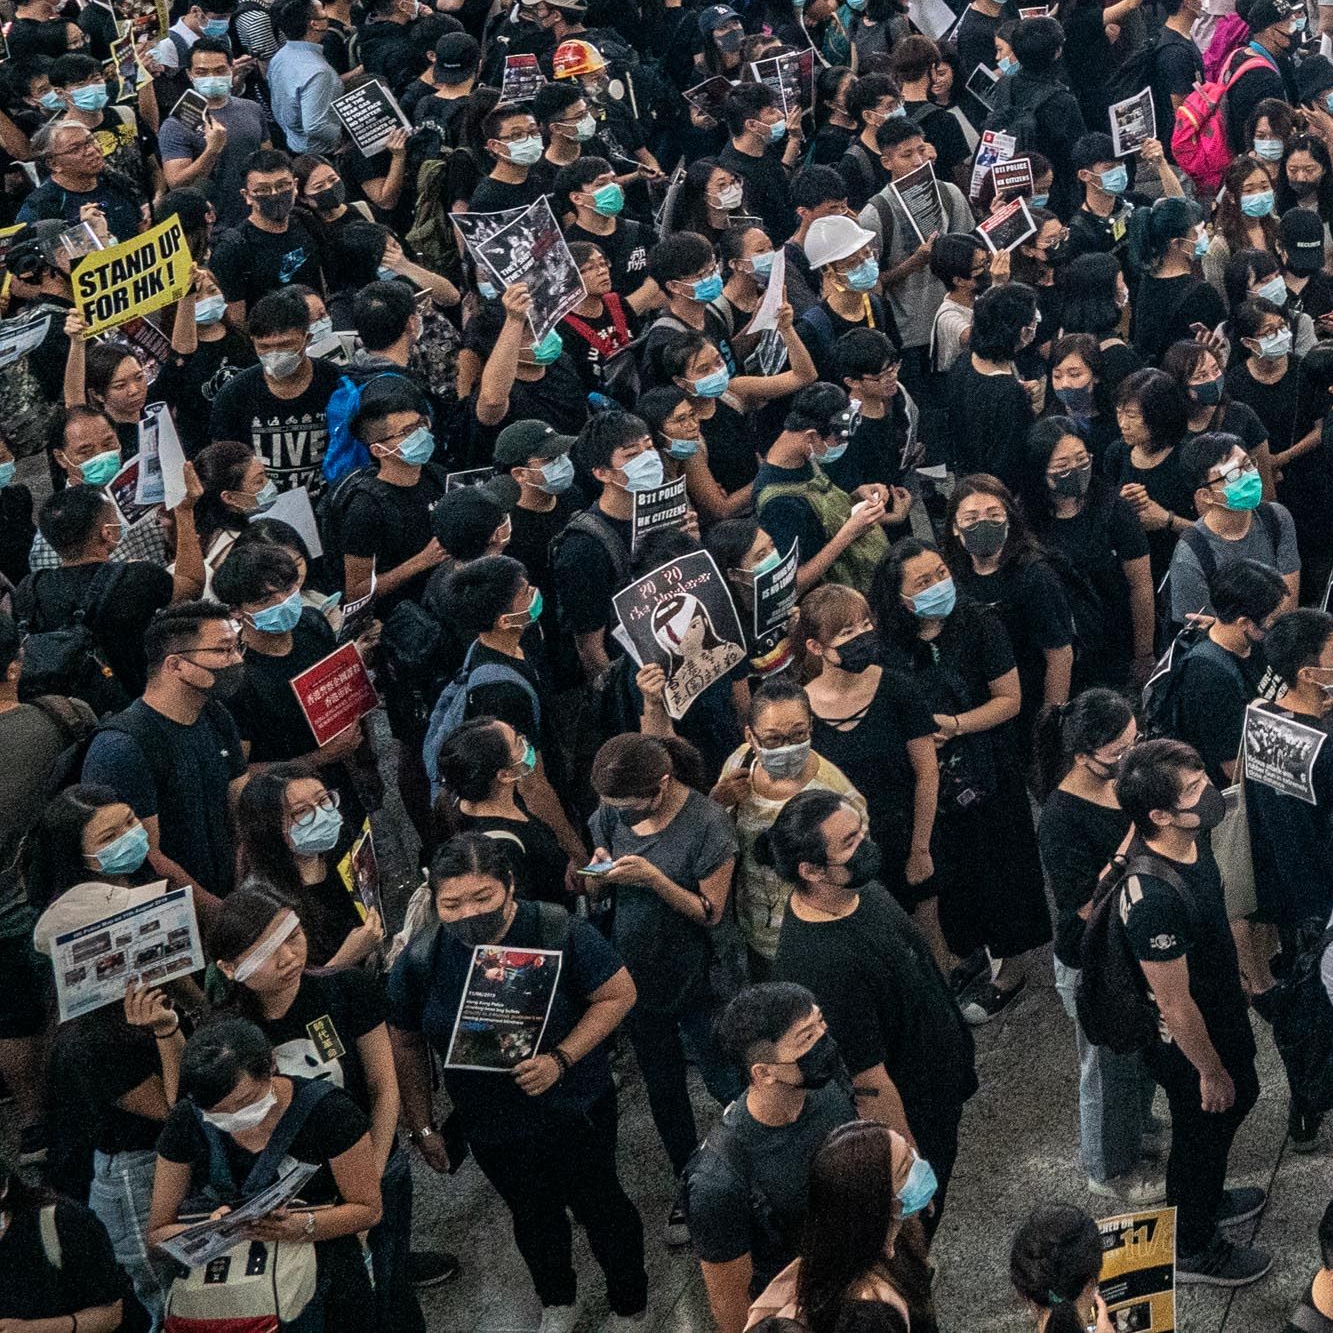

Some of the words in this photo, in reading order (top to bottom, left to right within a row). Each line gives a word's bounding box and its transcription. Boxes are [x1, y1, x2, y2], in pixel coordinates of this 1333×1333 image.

[336, 100, 345, 108] HK
[346, 89, 366, 102] POLICE
[339, 103, 351, 113] FIRE
[352, 96, 366, 106] THE
[342, 106, 357, 117] TEAR
[359, 99, 372, 109] GAS
[349, 119, 358, 128] NO
[359, 107, 382, 123] MATTER
[352, 106, 368, 118] YOUR
[368, 100, 382, 112] FACE
[1006, 162, 1028, 173] POLICE
[1005, 174, 1030, 185] CITIZENS
[79, 241, 156, 299] STAND
[161, 230, 181, 259] UP
[83, 288, 129, 327] FOR
[253, 430, 327, 468] LIVE
[638, 491, 658, 506] 811
[658, 481, 685, 502] POLICE
[637, 515, 652, 527] HK
[652, 503, 687, 522] CITIZENS
[1282, 777, 1308, 793] extremely
